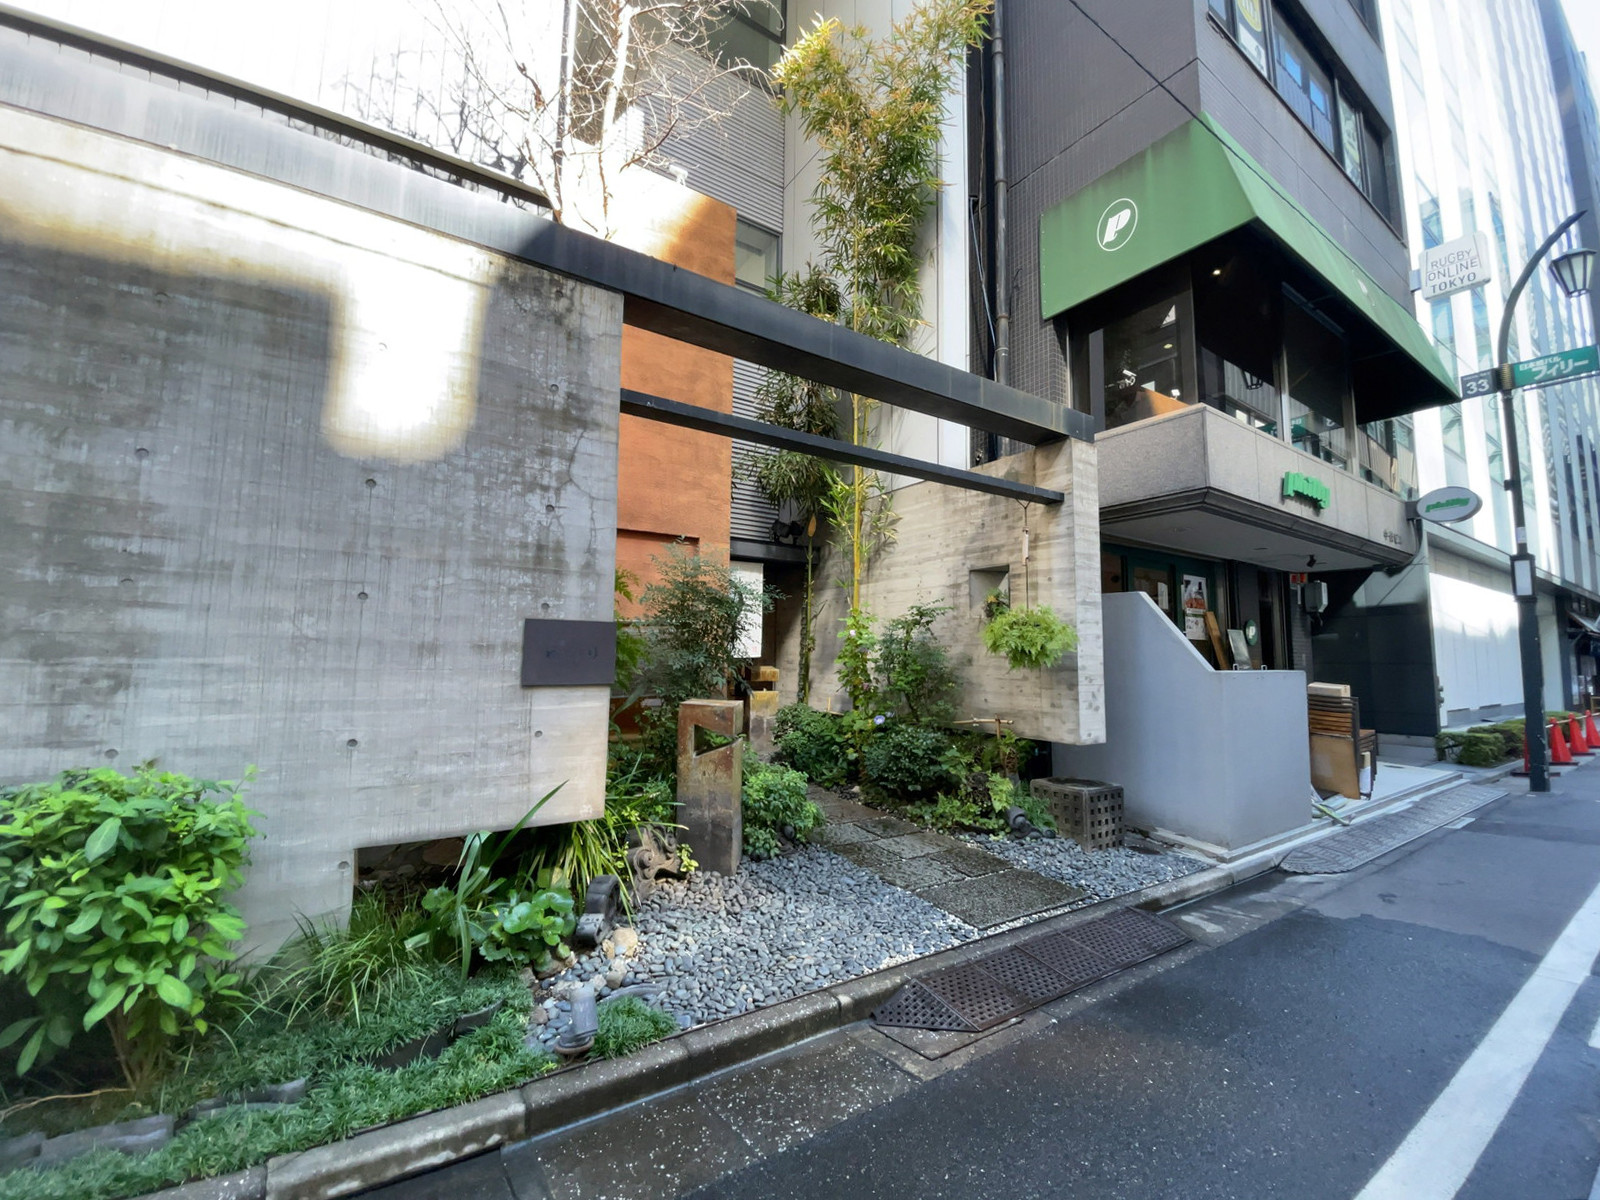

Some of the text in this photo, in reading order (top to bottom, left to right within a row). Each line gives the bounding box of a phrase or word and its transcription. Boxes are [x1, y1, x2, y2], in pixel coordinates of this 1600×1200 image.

[1428, 257, 1478, 281] ONLINE
[1430, 248, 1472, 269] RUGBY
[1430, 272, 1477, 293] TOKYO
[1531, 359, 1589, 380] フィリー
[1466, 380, 1490, 394] 33
